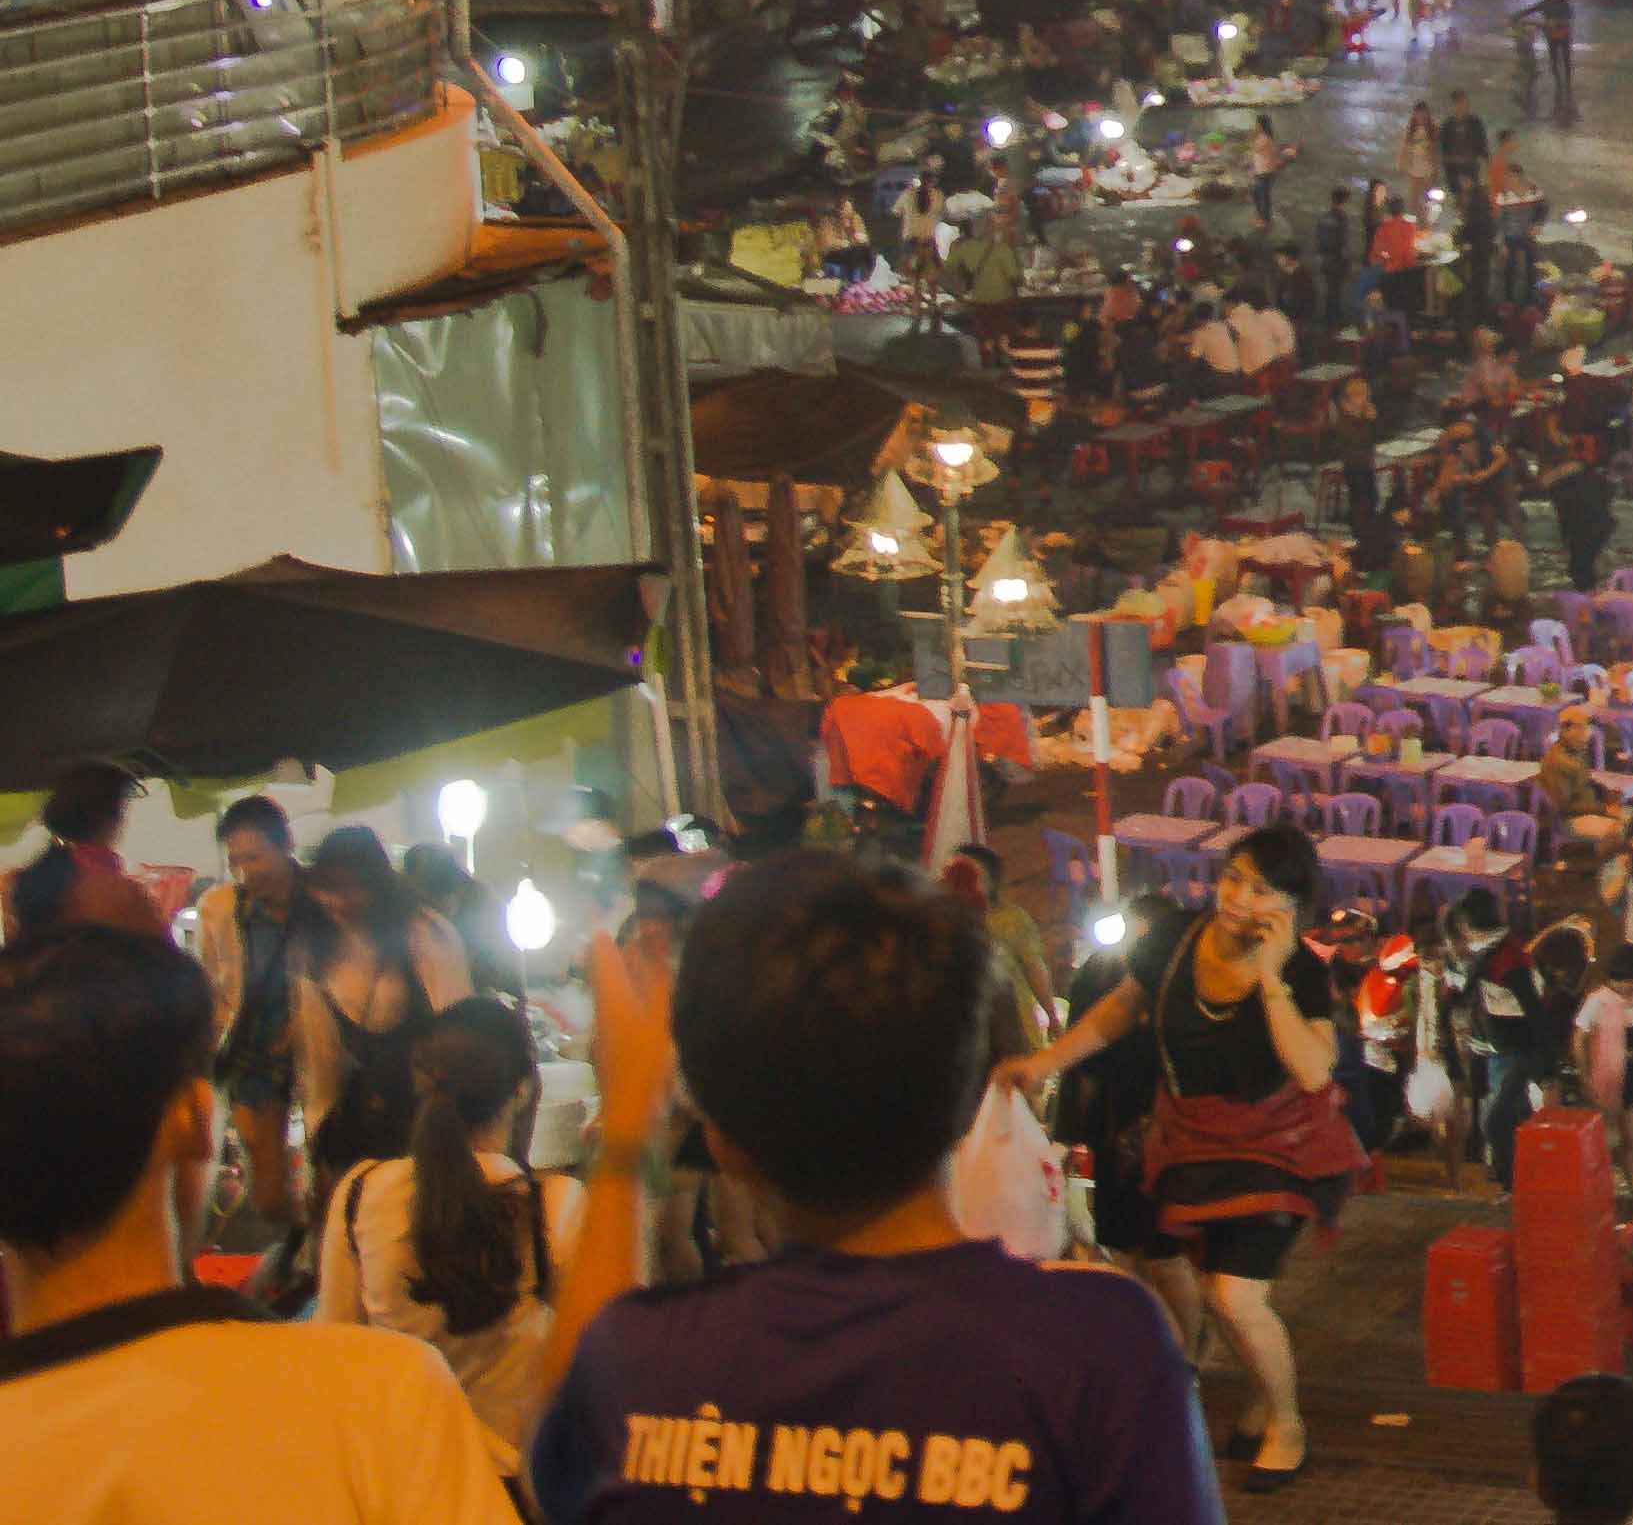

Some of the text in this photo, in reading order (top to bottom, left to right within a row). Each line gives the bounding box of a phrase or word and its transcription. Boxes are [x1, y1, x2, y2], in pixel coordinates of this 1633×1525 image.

[624, 1402, 1032, 1514] THIỆN NGỌC BBC
